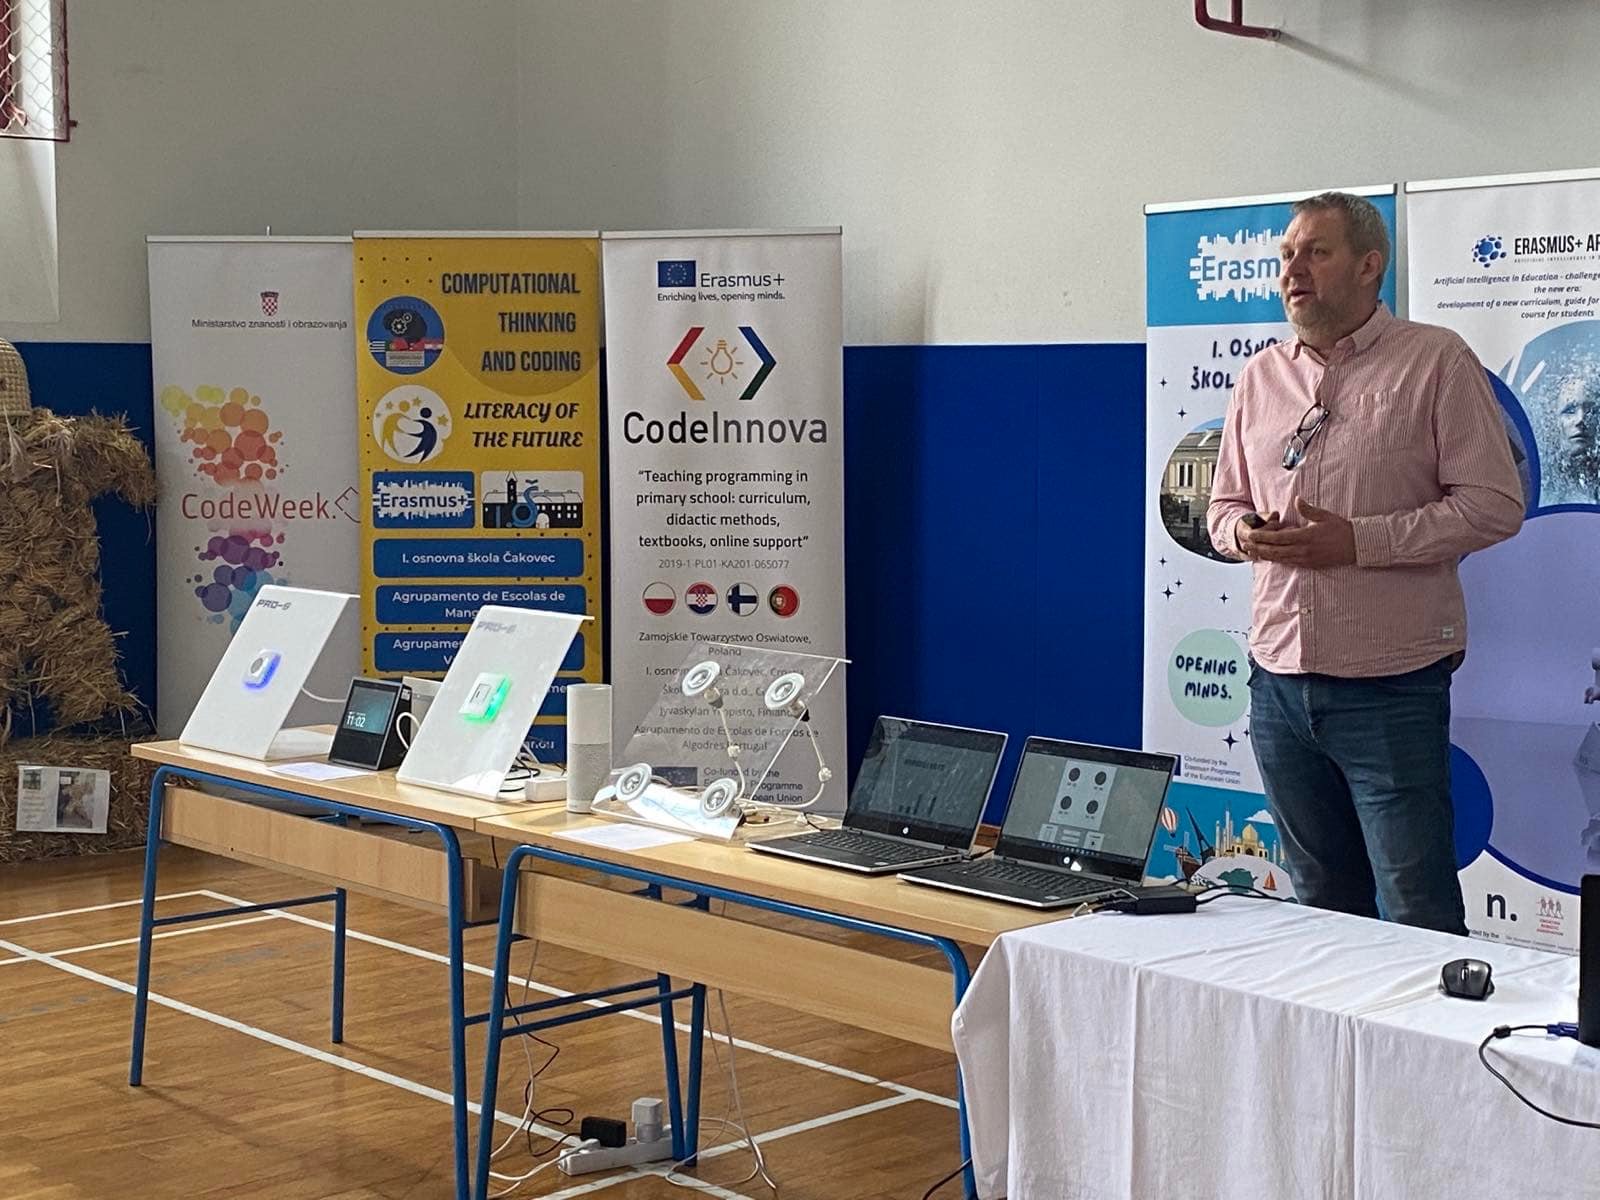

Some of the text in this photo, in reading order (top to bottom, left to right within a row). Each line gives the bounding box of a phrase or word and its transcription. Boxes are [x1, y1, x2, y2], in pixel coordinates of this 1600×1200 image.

[1514, 235, 1583, 255] ERASMUS+
[441, 272, 581, 296] COMPUTATIONAL
[700, 272, 785, 288] Erasmus+
[1433, 276, 1465, 287] Artificial
[1466, 275, 1510, 285] Intelligence
[1521, 273, 1558, 282] Education
[657, 291, 785, 302] Enriching lives, opening minds.
[1437, 300, 1484, 310] development
[1486, 299, 1495, 309] of
[1564, 298, 1586, 307] guide
[1521, 309, 1594, 319] course for students
[192, 319, 247, 329] Ministarstvo
[248, 319, 286, 329] znanosti
[292, 319, 348, 331] obrazovanja
[498, 311, 576, 333] THINKING
[481, 350, 581, 373] AND CODING
[464, 403, 580, 424] LITERACY OF
[623, 411, 828, 444] CodeInnova
[472, 431, 583, 448] THE FUTURE
[706, 470, 793, 485] programming
[796, 470, 808, 482] in
[380, 493, 467, 509] Erasmus+
[636, 492, 811, 507] primary school: curriculum,
[666, 513, 780, 527] didactic methods,
[639, 535, 706, 548] textbooks,
[710, 535, 750, 547] online
[412, 555, 465, 564] osnovna
[468, 552, 500, 564] škola
[503, 550, 556, 564] Čakovec
[392, 591, 566, 604] Agrupamento de Escolas de
[639, 633, 689, 644] Zamojskie
[691, 633, 754, 645] Towarzystwo
[1176, 655, 1238, 676] OPENING
[1184, 682, 1233, 701] MINDS.
[717, 726, 753, 736] Esolas
[755, 727, 768, 736] de
[703, 767, 749, 777] Co-fundd
[777, 794, 803, 802] Union
